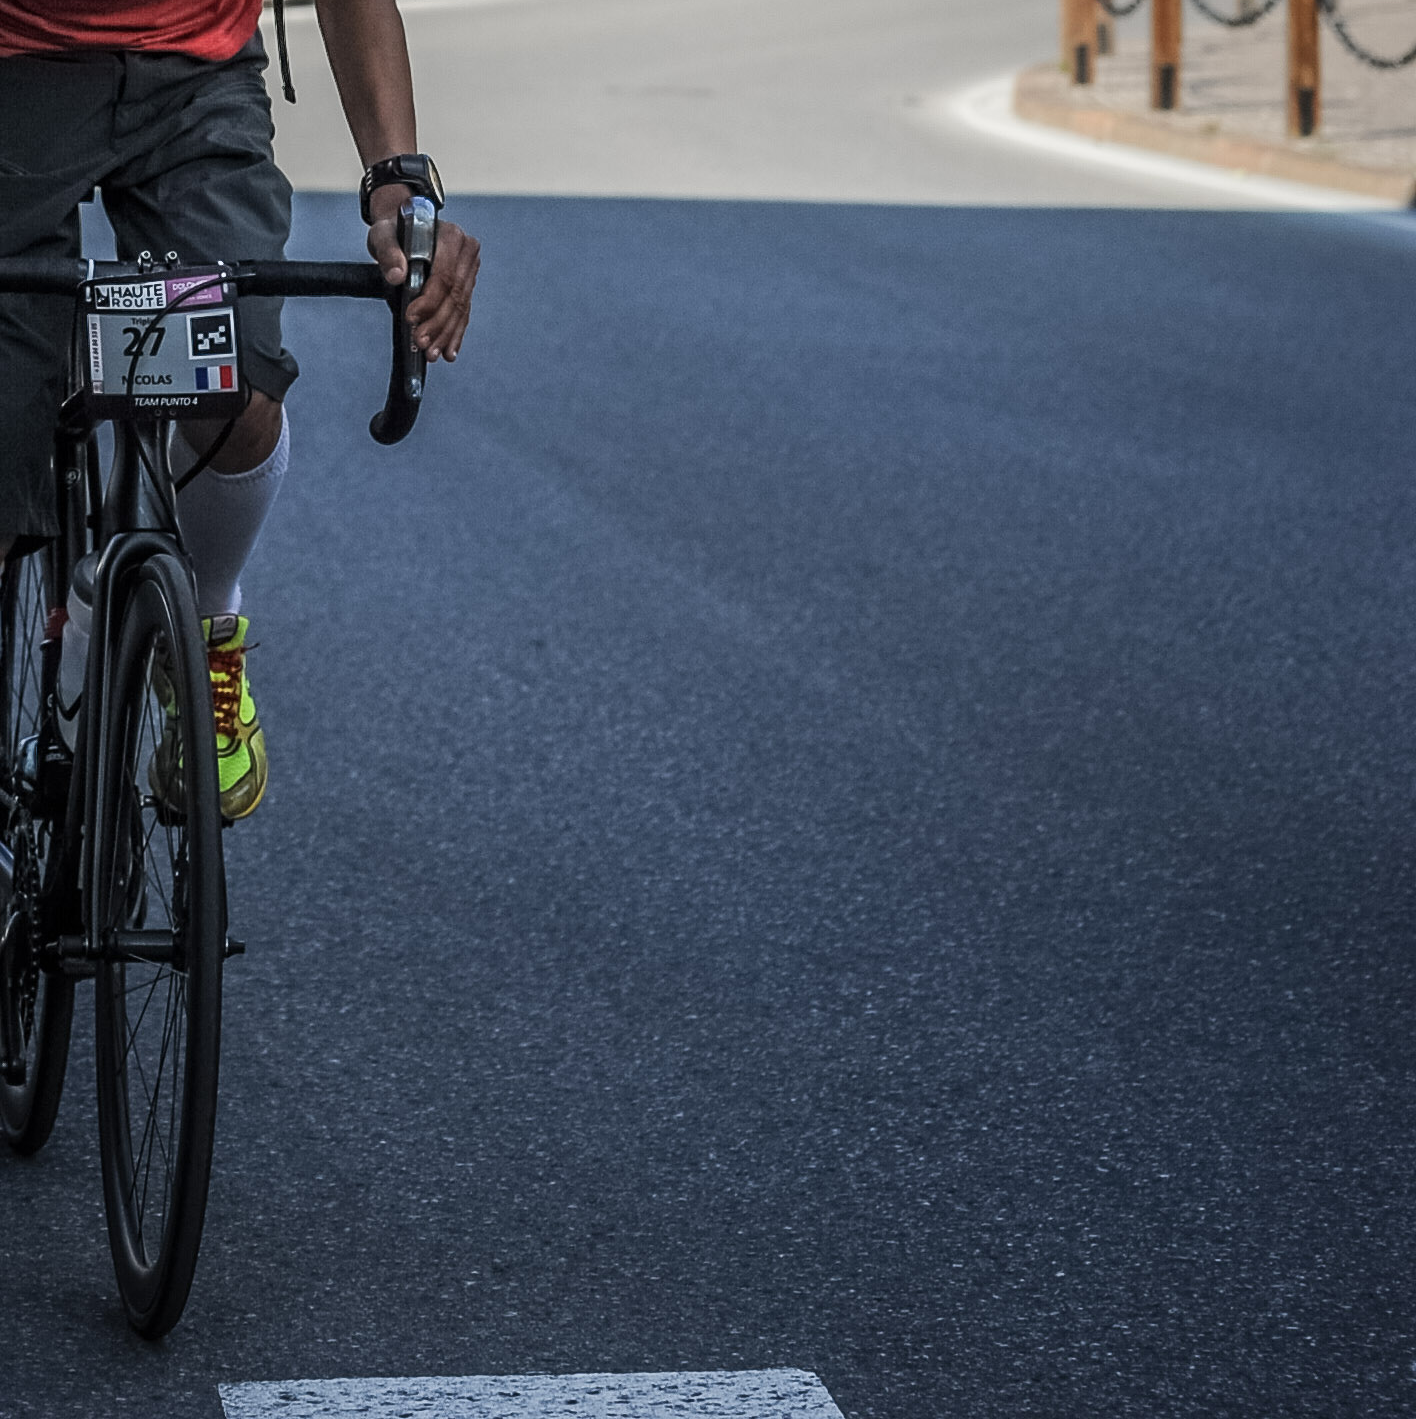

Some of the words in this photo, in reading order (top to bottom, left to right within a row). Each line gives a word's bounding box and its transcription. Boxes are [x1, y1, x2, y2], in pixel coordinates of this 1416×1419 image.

[111, 283, 163, 299] HAUTE
[111, 297, 164, 308] ROUTE
[122, 326, 166, 357] 27
[121, 374, 173, 386] NCOLAS
[134, 397, 159, 406] TEAM
[160, 396, 191, 406] PUNTO
[191, 396, 198, 405] 4
